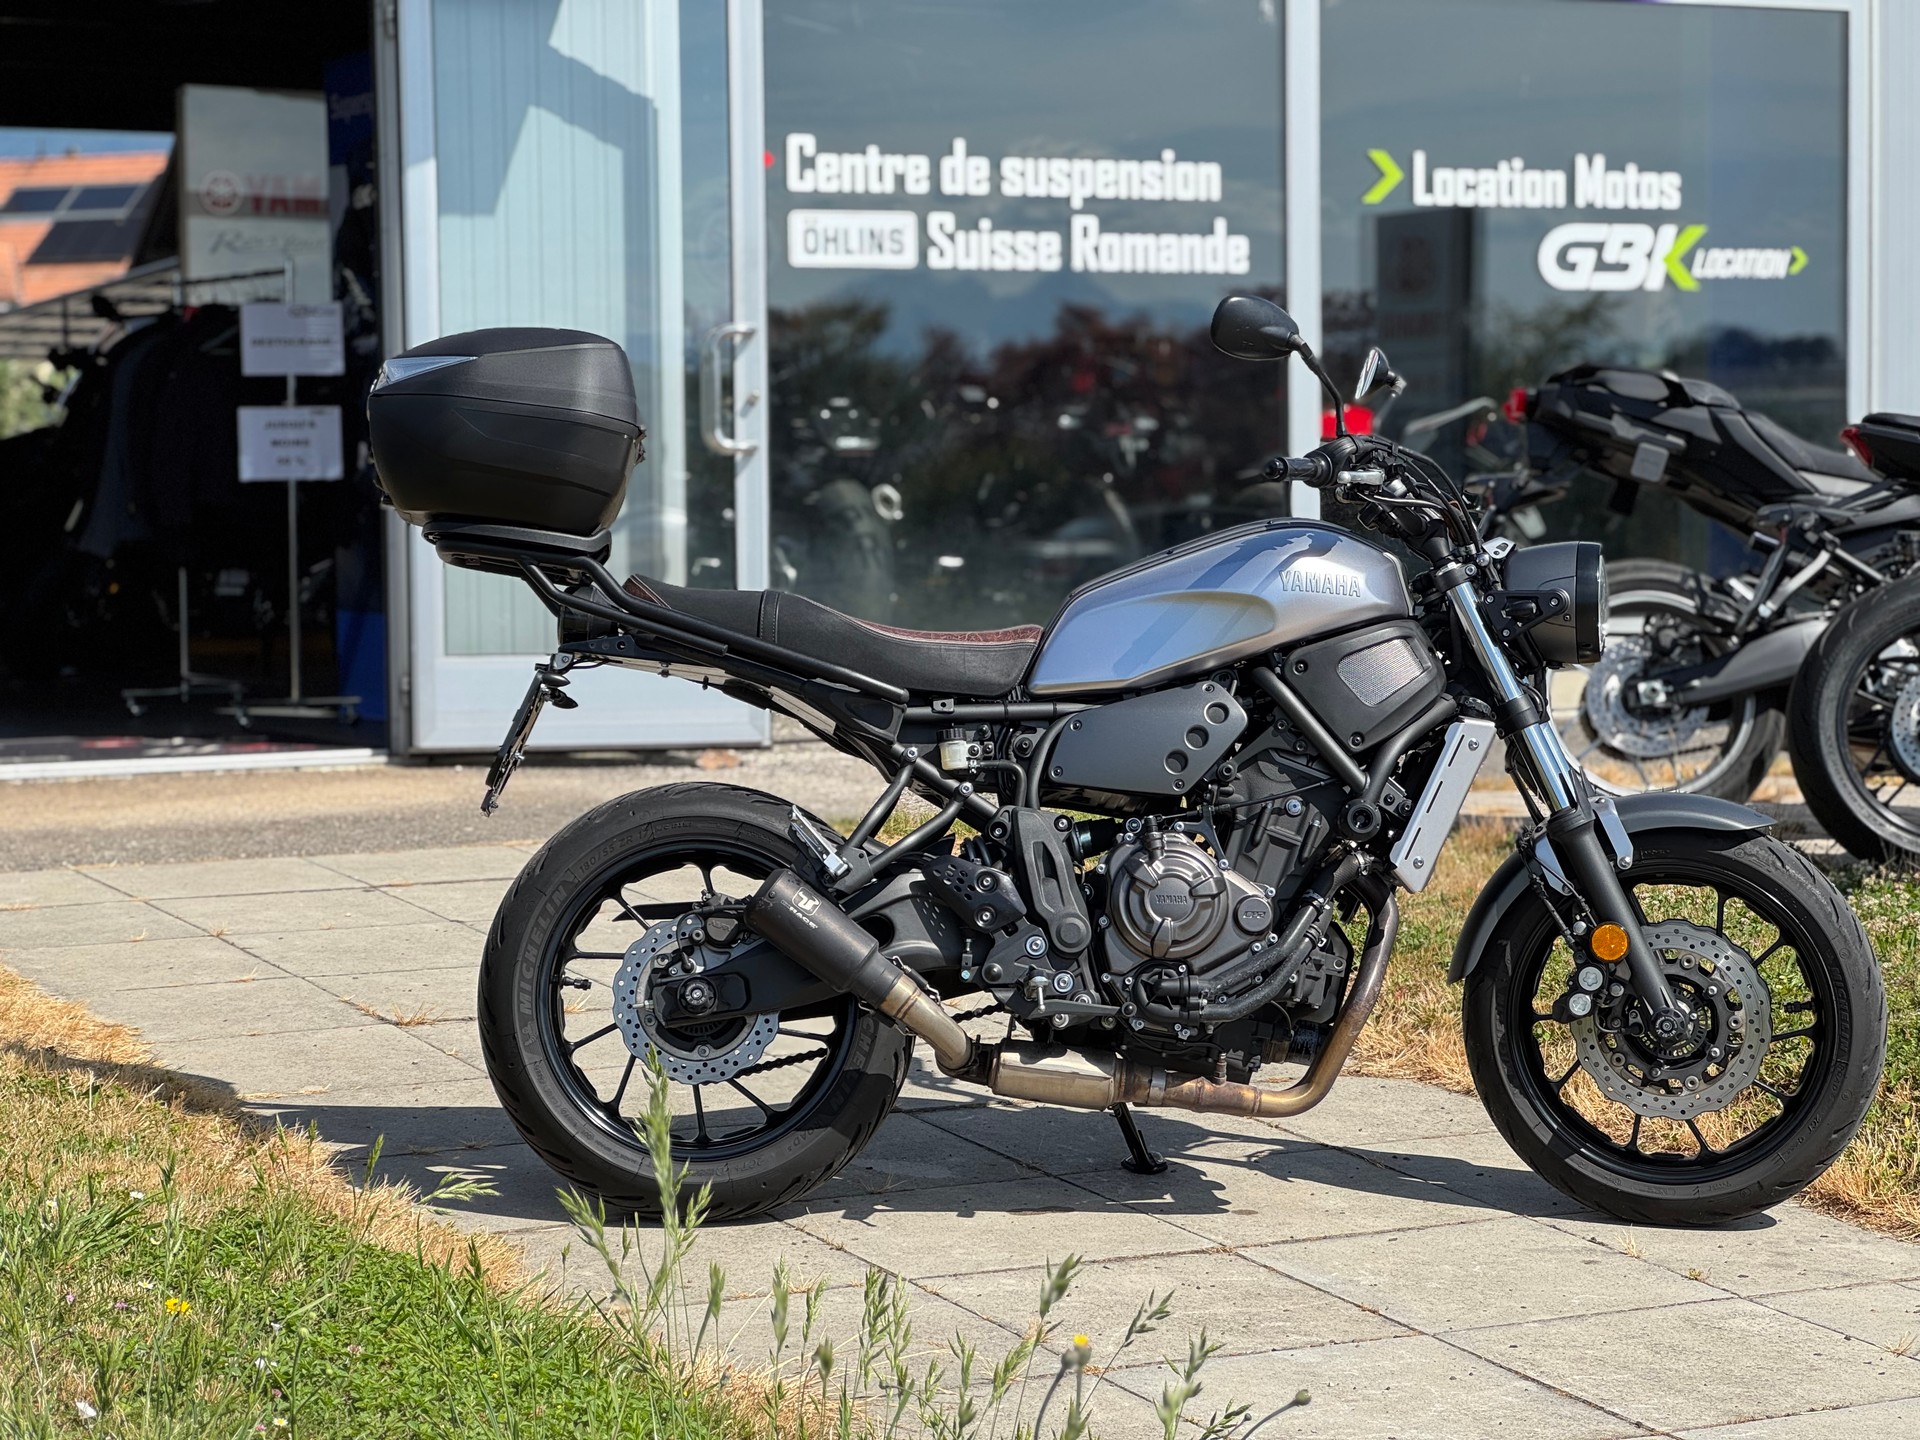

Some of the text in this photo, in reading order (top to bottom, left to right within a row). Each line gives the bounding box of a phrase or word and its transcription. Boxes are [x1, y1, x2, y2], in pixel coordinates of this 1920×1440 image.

[786, 132, 1222, 210] Centre de suspension
[1412, 149, 1682, 210] Location Motos
[926, 210, 1063, 271] Suisse
[1070, 214, 1250, 275] Romande
[1537, 222, 1792, 291] GBK LOCATION
[1278, 569, 1361, 598] YAMAHA
[1155, 894, 1188, 905] YAMAHA
[519, 884, 569, 1016] MICHELIN
[1831, 966, 1851, 1050] MICHELIN
